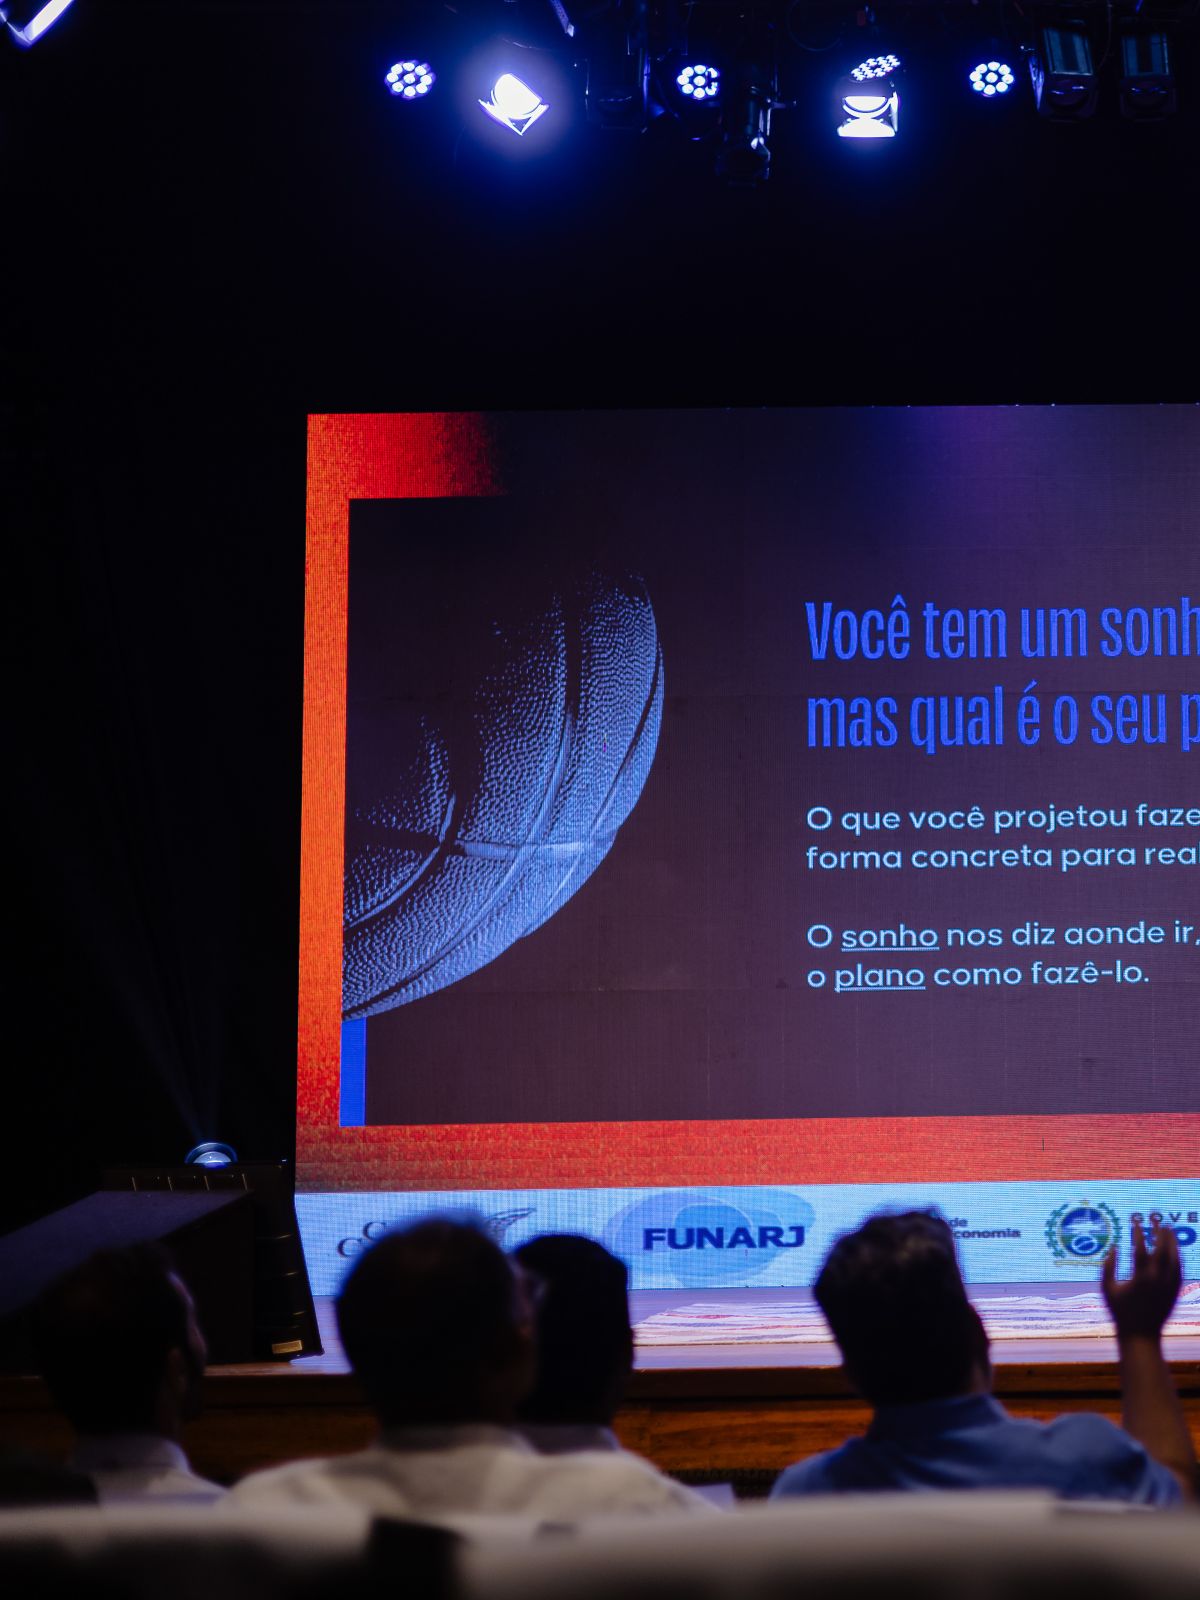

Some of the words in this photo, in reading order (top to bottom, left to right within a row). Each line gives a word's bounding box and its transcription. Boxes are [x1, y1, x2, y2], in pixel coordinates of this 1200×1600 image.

[804, 593, 911, 661] Você
[922, 602, 1008, 659] tem
[1020, 607, 1088, 658] um
[807, 696, 899, 748] mas
[909, 684, 1004, 755] qual
[1017, 679, 1041, 747] é
[1053, 695, 1079, 745] o
[1090, 693, 1167, 745] seu
[806, 806, 833, 831] O
[841, 811, 901, 837] que
[908, 805, 986, 830] você
[994, 803, 1128, 834] projetou
[805, 846, 902, 869] forma
[911, 844, 1052, 868] concreta
[1061, 847, 1137, 873] para
[807, 924, 833, 949] O
[841, 923, 940, 953] sonho
[947, 928, 1003, 947] nos
[1011, 921, 1056, 946] diz
[1064, 920, 1166, 945] aonde
[807, 969, 827, 988] o
[834, 963, 926, 993] plano
[933, 967, 1023, 986] como
[1029, 958, 1151, 986] fazê-lo.
[643, 1225, 805, 1251] FUNARJ
[952, 1228, 1021, 1238] conomia
